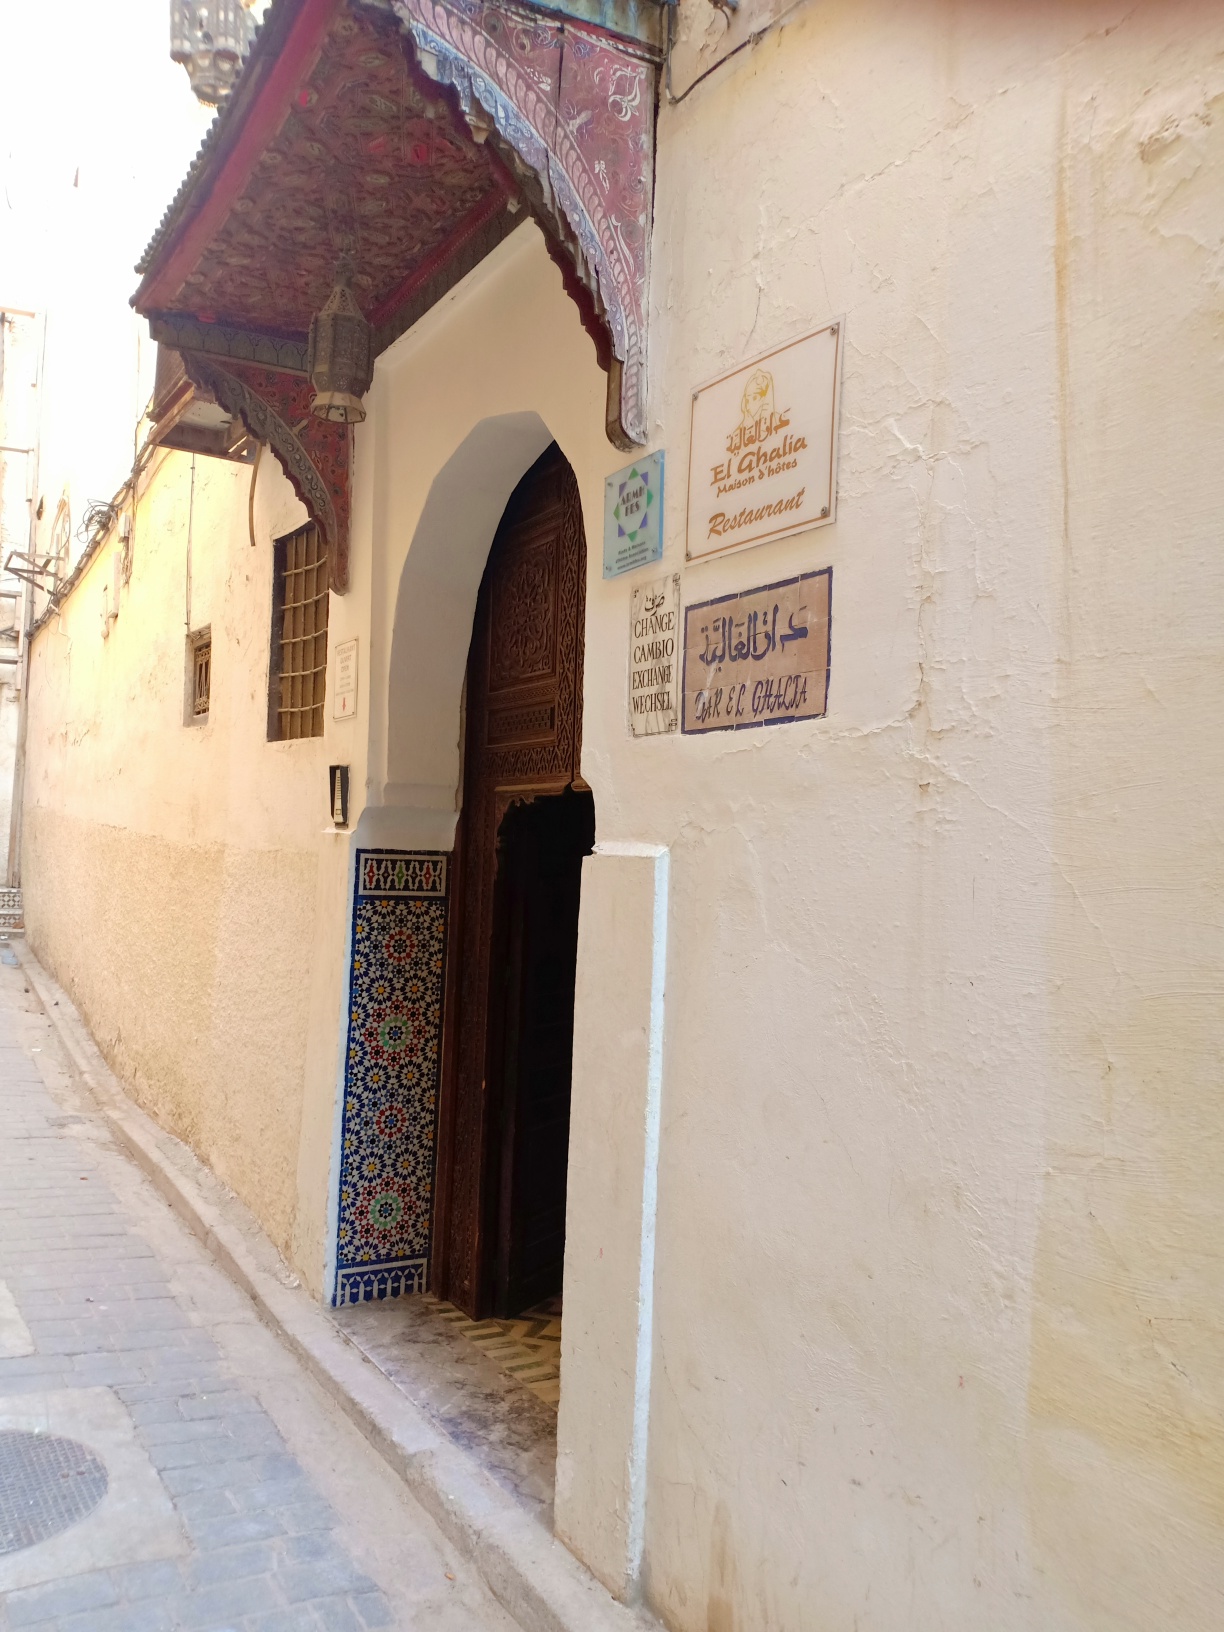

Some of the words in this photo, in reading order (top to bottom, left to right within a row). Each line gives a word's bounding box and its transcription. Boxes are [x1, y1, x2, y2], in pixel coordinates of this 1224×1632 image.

[710, 458, 732, 486] El
[737, 434, 808, 475] Ghalia
[716, 475, 755, 498] Maison
[758, 458, 798, 480] d'hôtes
[625, 500, 641, 517] FES
[707, 487, 806, 539] Restaurant
[634, 611, 675, 639] CHANGE
[633, 638, 674, 665] CAMBIO
[632, 664, 674, 690] EXCHANGE
[632, 691, 673, 715] WECHSEL
[694, 687, 723, 724] DAR
[725, 685, 746, 716] EL
[752, 675, 808, 719] GHALIA
